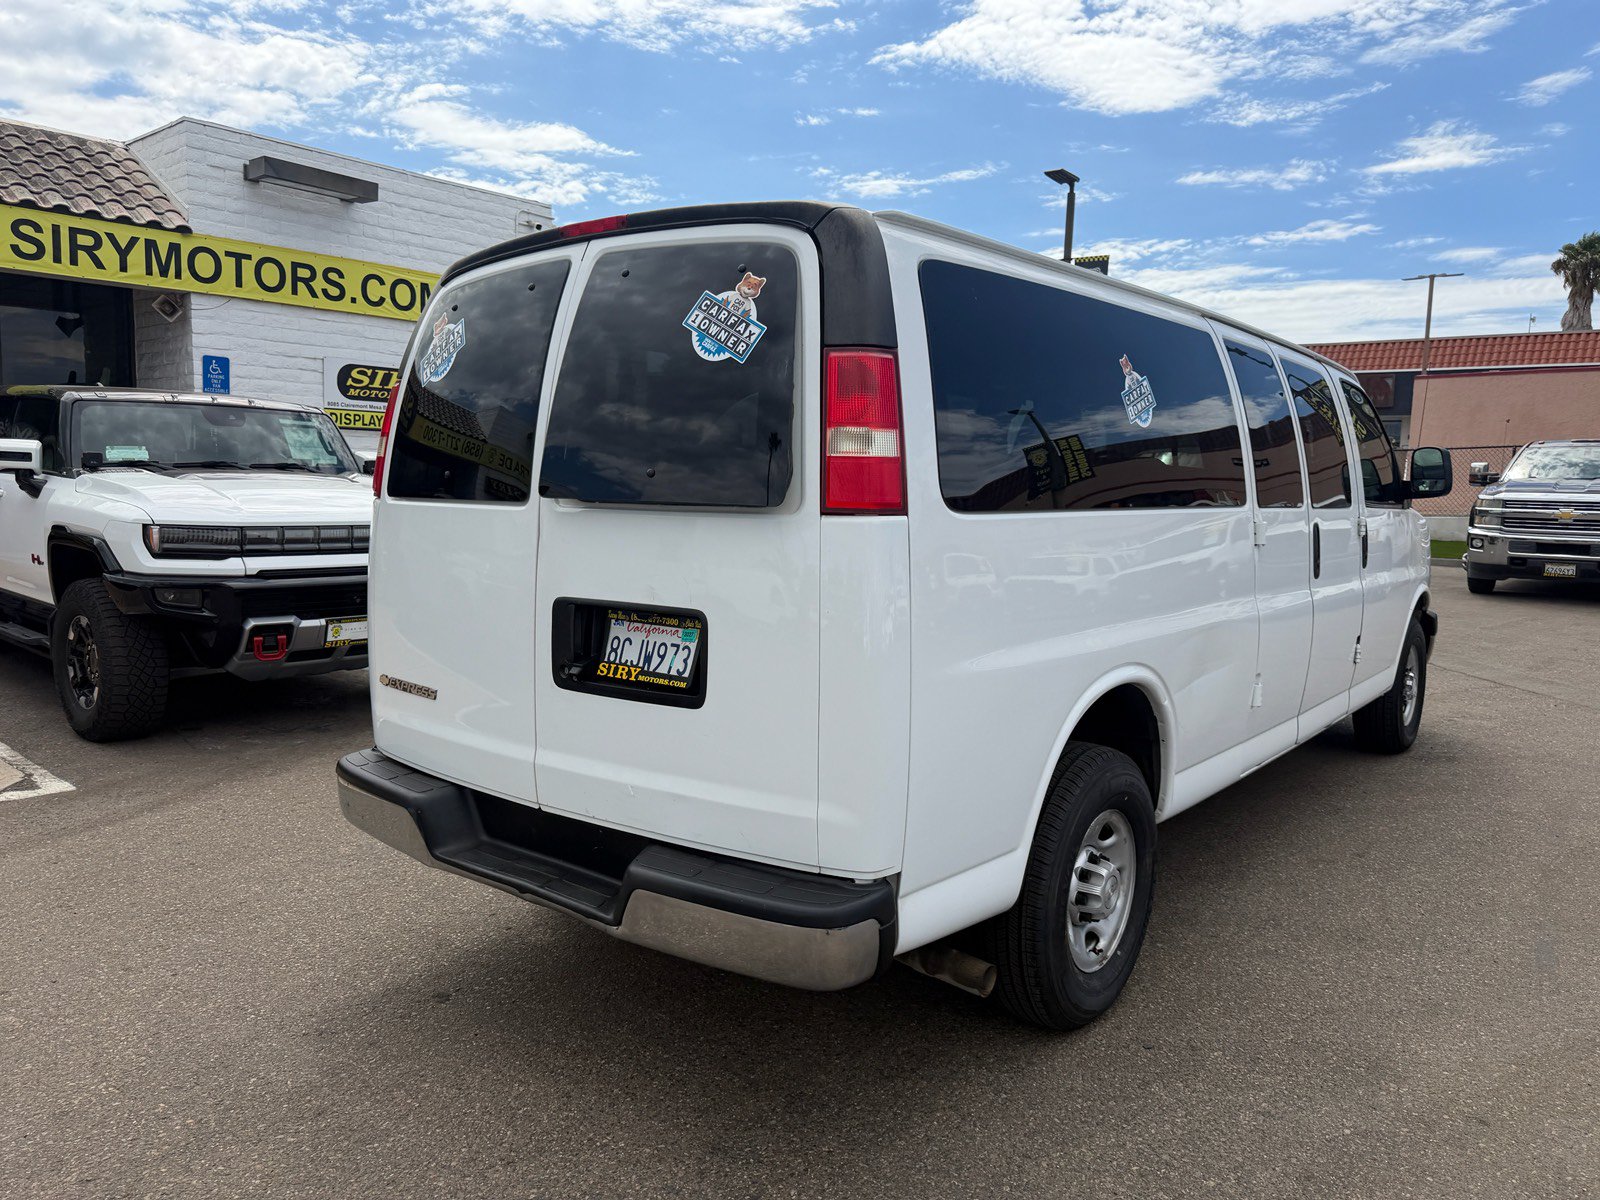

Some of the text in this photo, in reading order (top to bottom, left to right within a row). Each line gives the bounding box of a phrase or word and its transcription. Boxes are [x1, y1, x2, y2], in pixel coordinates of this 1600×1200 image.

[701, 300, 756, 340] CARFAX
[691, 313, 701, 324] 1
[700, 318, 748, 354] OWNER
[423, 328, 462, 369] CARFAX
[347, 388, 391, 399] MOTO
[1125, 384, 1150, 405] CARFAX
[328, 412, 384, 428] DISPLAY
[627, 622, 682, 639] California
[607, 635, 692, 677] 8CJW973
[389, 677, 438, 700] EXPRESS
